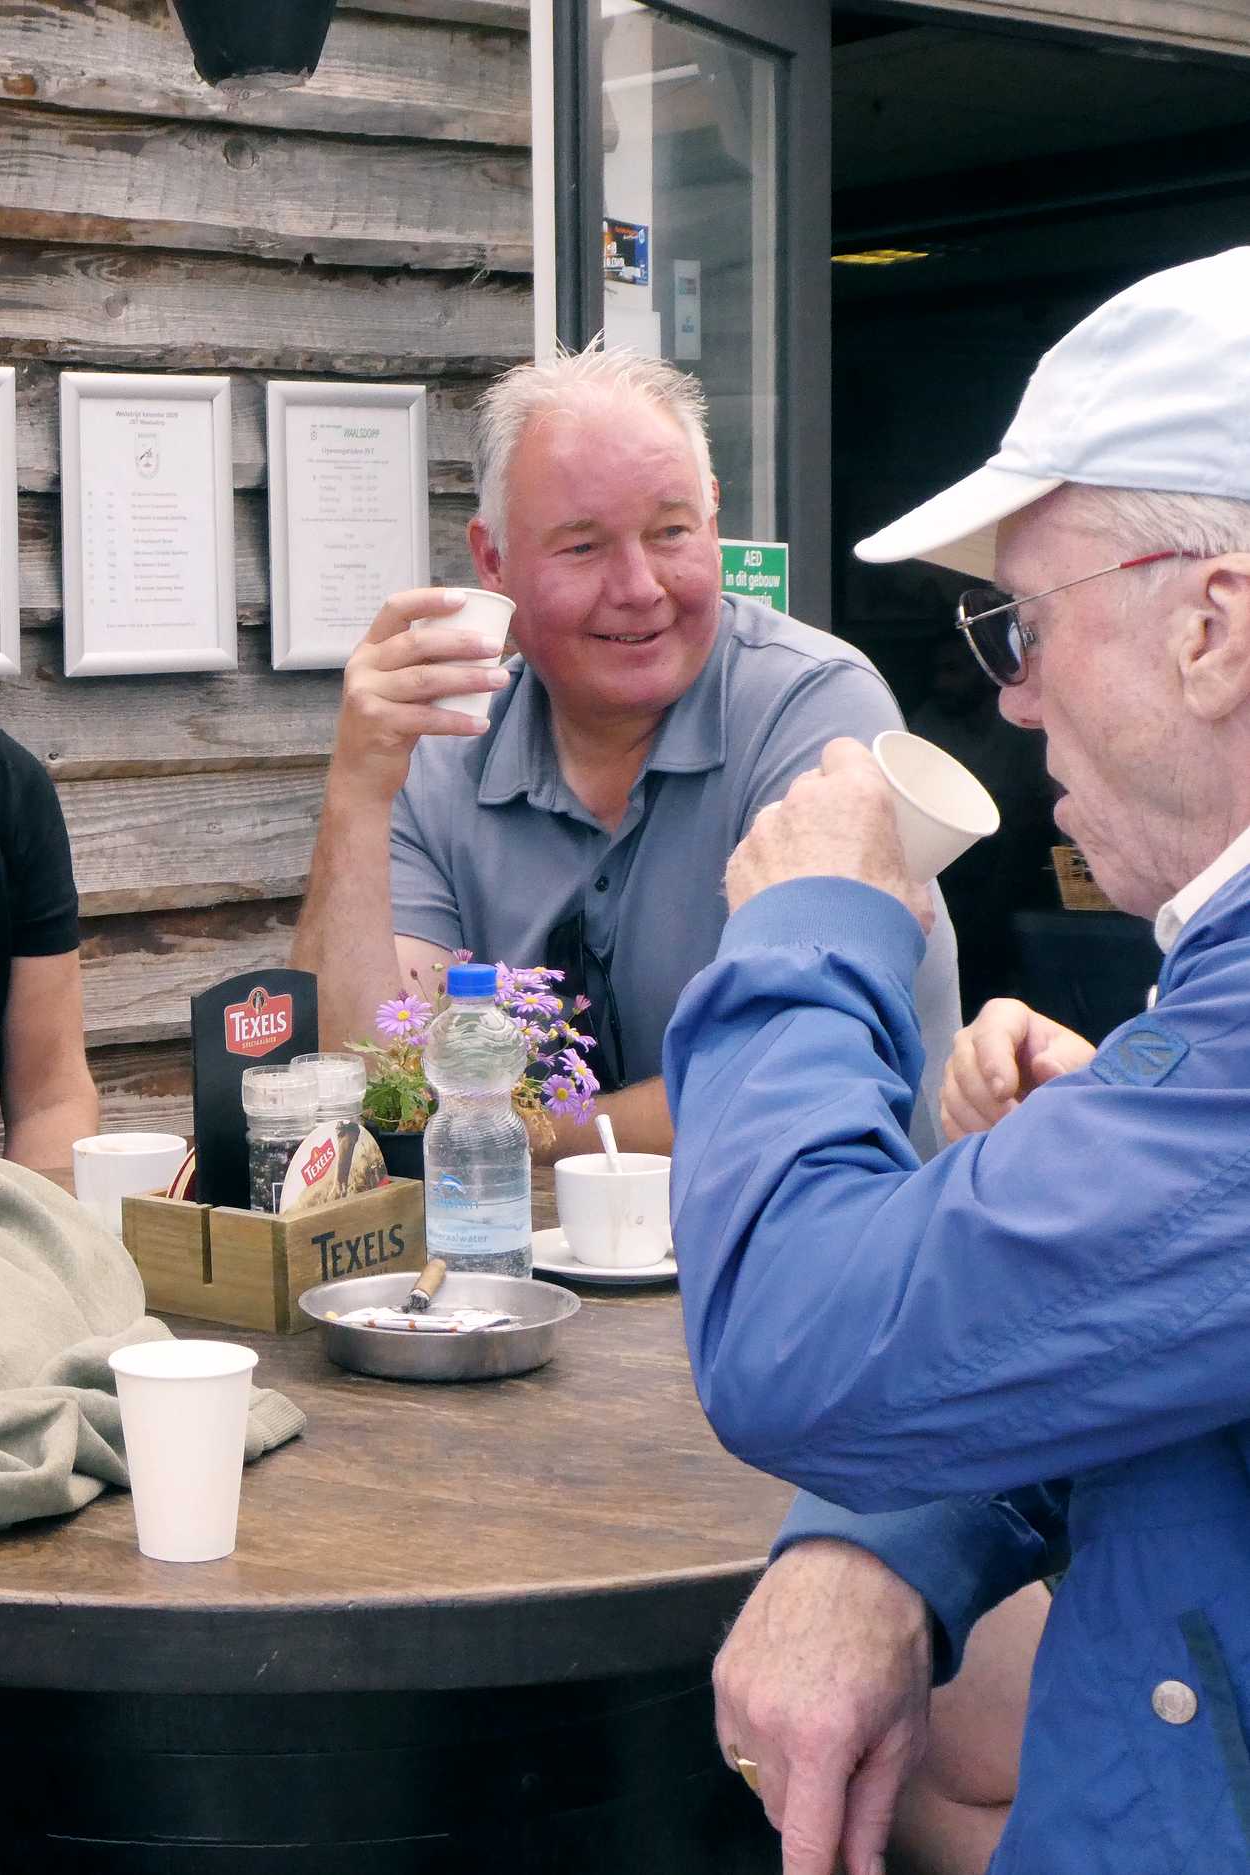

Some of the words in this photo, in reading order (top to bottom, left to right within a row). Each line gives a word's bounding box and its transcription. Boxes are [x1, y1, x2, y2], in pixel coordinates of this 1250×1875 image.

[744, 550, 763, 567] AED
[725, 570, 734, 586] in
[736, 570, 747, 586] dit
[748, 572, 781, 591] gebouw
[229, 1011, 287, 1042] TEXELS
[304, 1147, 335, 1181] TEXELS
[311, 1223, 405, 1281] TEXELS
